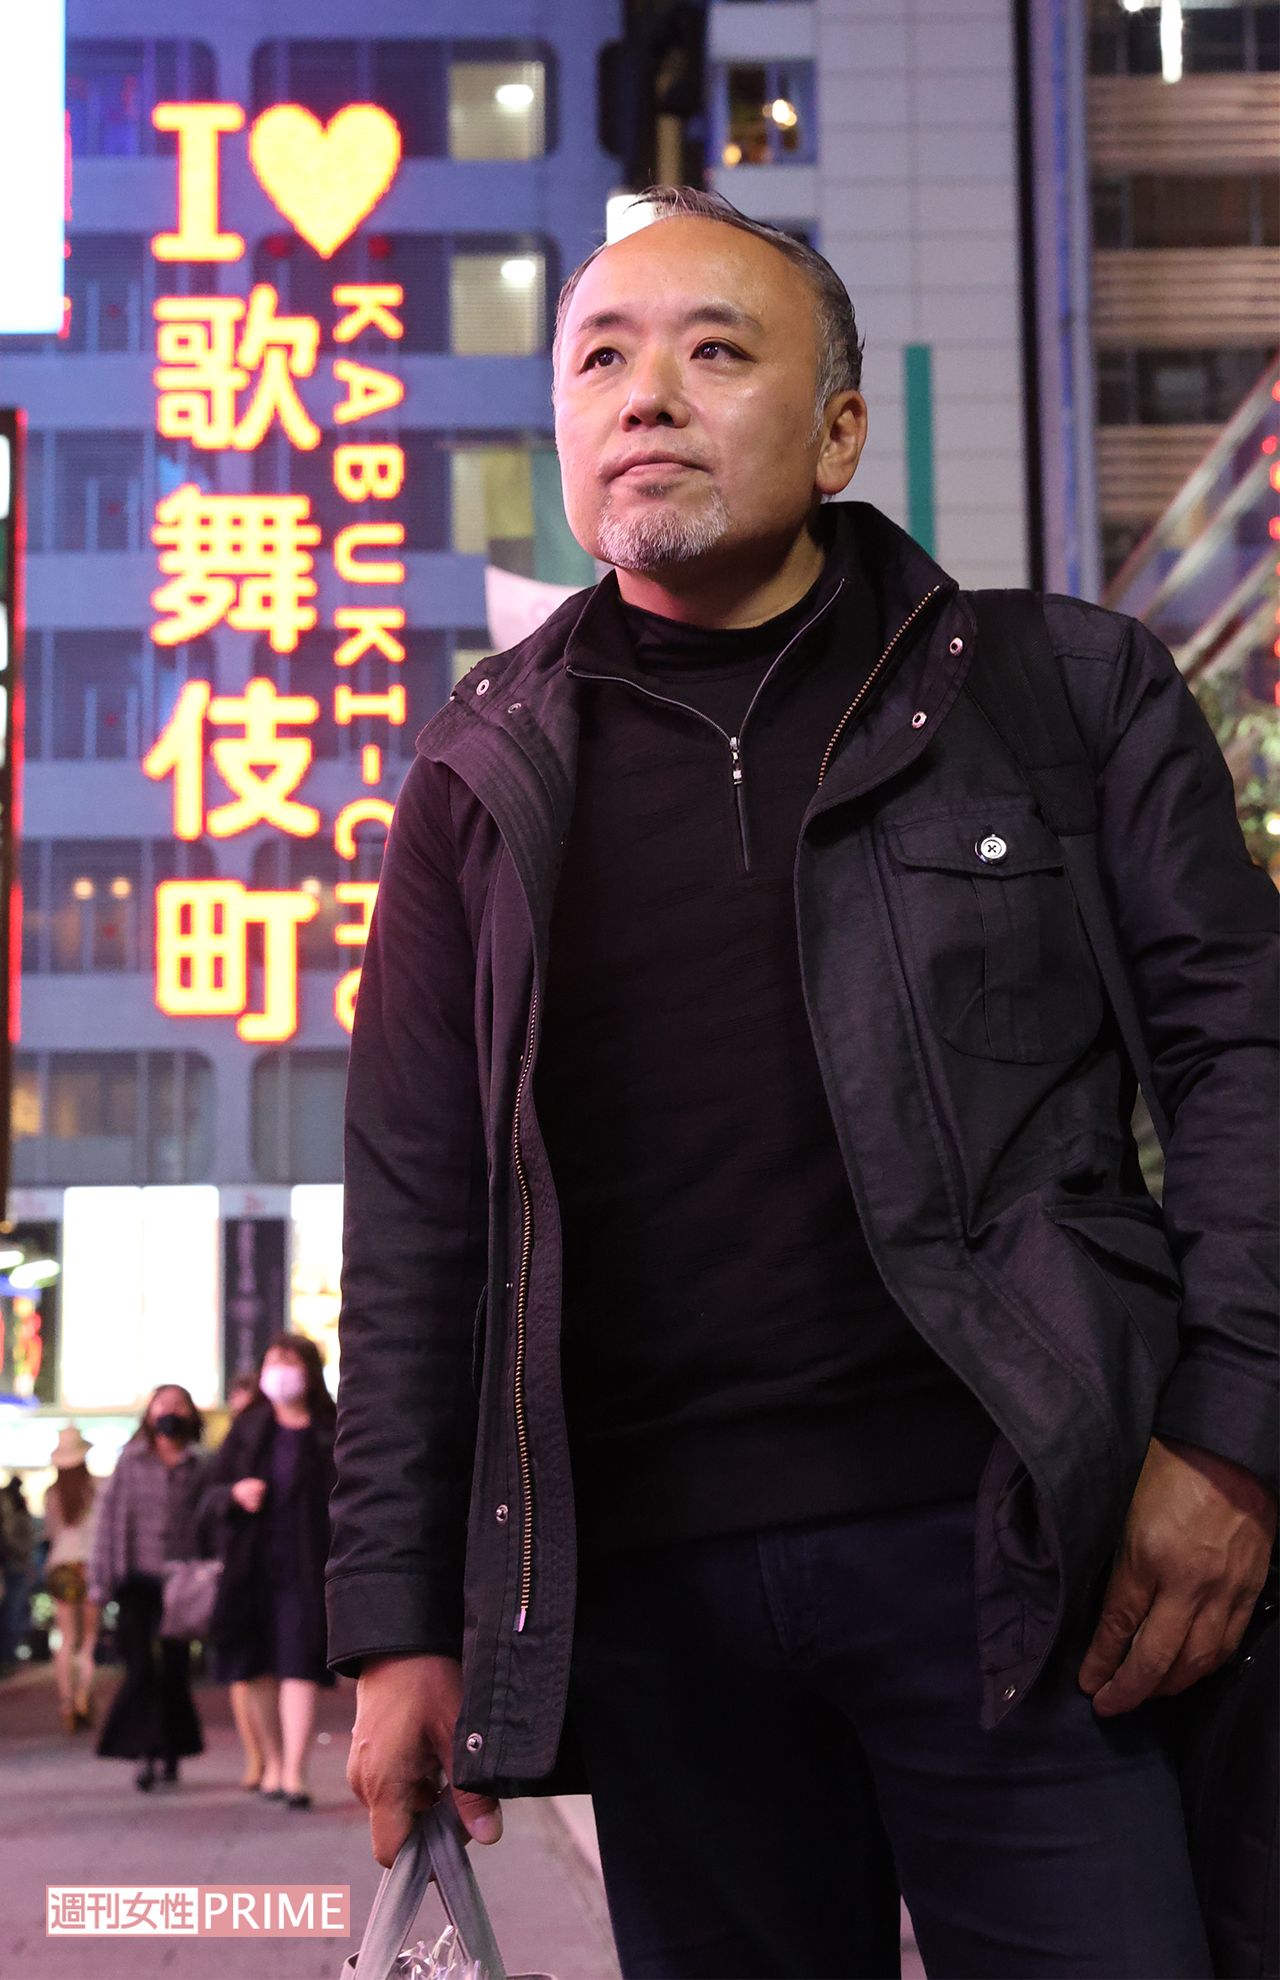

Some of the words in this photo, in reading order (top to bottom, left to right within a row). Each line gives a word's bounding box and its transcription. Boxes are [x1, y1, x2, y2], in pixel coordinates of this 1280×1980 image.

[152, 102, 245, 262] I
[142, 284, 322, 1044] 歌舞伎町
